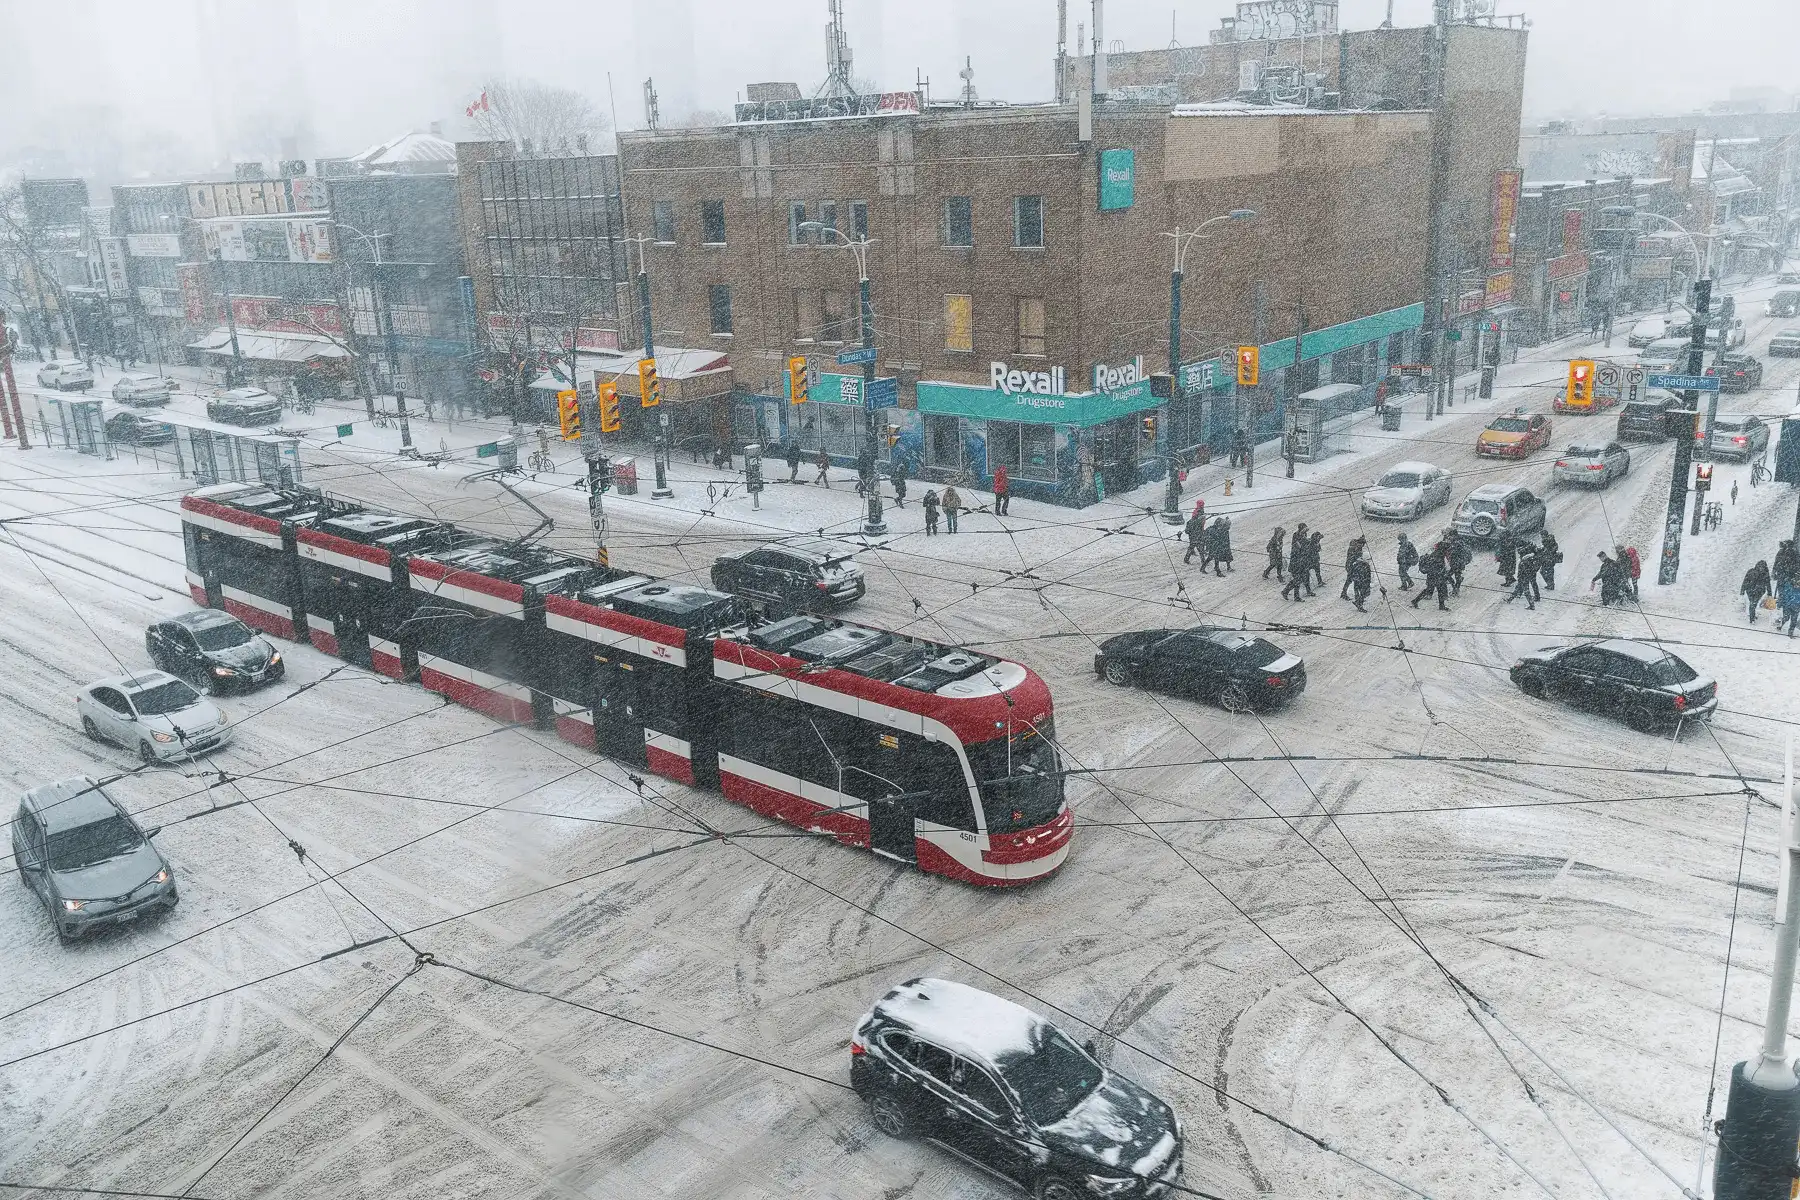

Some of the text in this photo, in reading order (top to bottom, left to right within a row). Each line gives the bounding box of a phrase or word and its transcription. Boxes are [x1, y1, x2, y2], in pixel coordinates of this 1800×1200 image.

[1107, 168, 1130, 182] Rexall
[842, 353, 862, 362] Dundas
[867, 351, 872, 359] W
[990, 361, 1065, 396] Rexall
[1096, 354, 1145, 392] Rexall
[1186, 363, 1214, 395] 藥店
[395, 381, 407, 390] 40
[1657, 375, 1697, 389] Spadina
[840, 377, 865, 404] 藥
[1112, 386, 1143, 402] Drugstore
[1017, 394, 1066, 409] Drugstore
[1032, 712, 1046, 723] 4501
[959, 832, 978, 844] 4501
